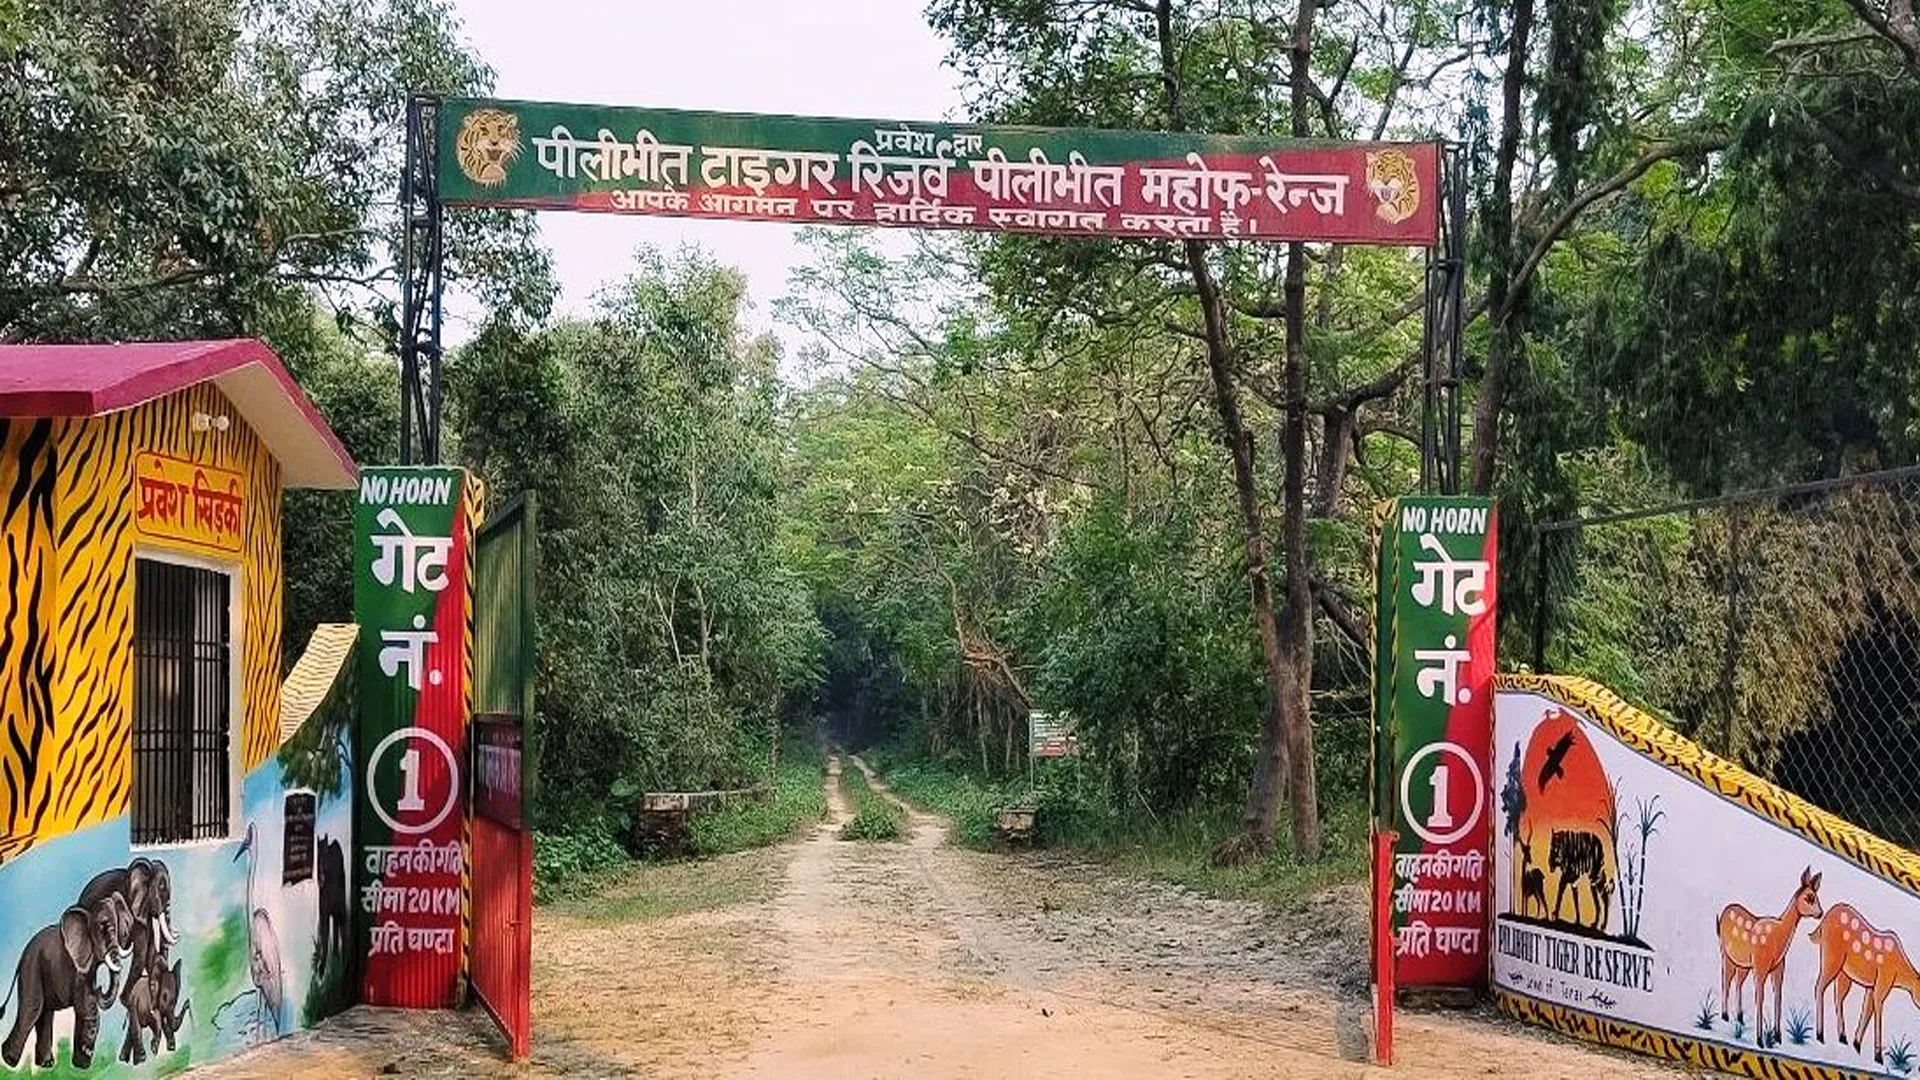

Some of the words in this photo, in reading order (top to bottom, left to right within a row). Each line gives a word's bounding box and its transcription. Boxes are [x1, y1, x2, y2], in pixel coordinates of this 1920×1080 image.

[532, 125, 693, 186] पीलीभीत
[701, 146, 839, 197] टाइगर
[847, 139, 956, 198] रिजर्व
[968, 147, 1125, 208] पीलीभीत
[875, 123, 935, 155] प्रवेश
[952, 133, 983, 158] द्वार
[609, 183, 691, 211] आपके
[699, 192, 798, 216] आगमन
[810, 199, 855, 220] पर
[873, 197, 978, 227] हार्दिक
[988, 207, 1107, 231] स्वागत
[1121, 213, 1212, 237] करता
[360, 475, 388, 505] NO
[389, 476, 452, 506] HORN
[1402, 506, 1428, 533] NO
[1430, 507, 1488, 535] HORN
[370, 507, 454, 594] गेट
[1411, 533, 1490, 616] गेट
[379, 614, 443, 691] नं.
[1414, 635, 1473, 706] नं.
[397, 749, 425, 811] 1
[1427, 765, 1453, 828] 1
[361, 879, 407, 914] सीमा
[408, 887, 430, 914] 20
[433, 887, 460, 916] KM
[1394, 883, 1431, 914] सीमा
[1431, 890, 1452, 912] 20
[1456, 890, 1481, 914] KM
[368, 920, 405, 958] प्रति
[406, 927, 456, 956] घण्टा
[1395, 920, 1433, 959] प्रति
[1434, 926, 1481, 956] घण्टा
[1544, 935, 1579, 976] TIGER
[1584, 943, 1655, 994] RESERVE
